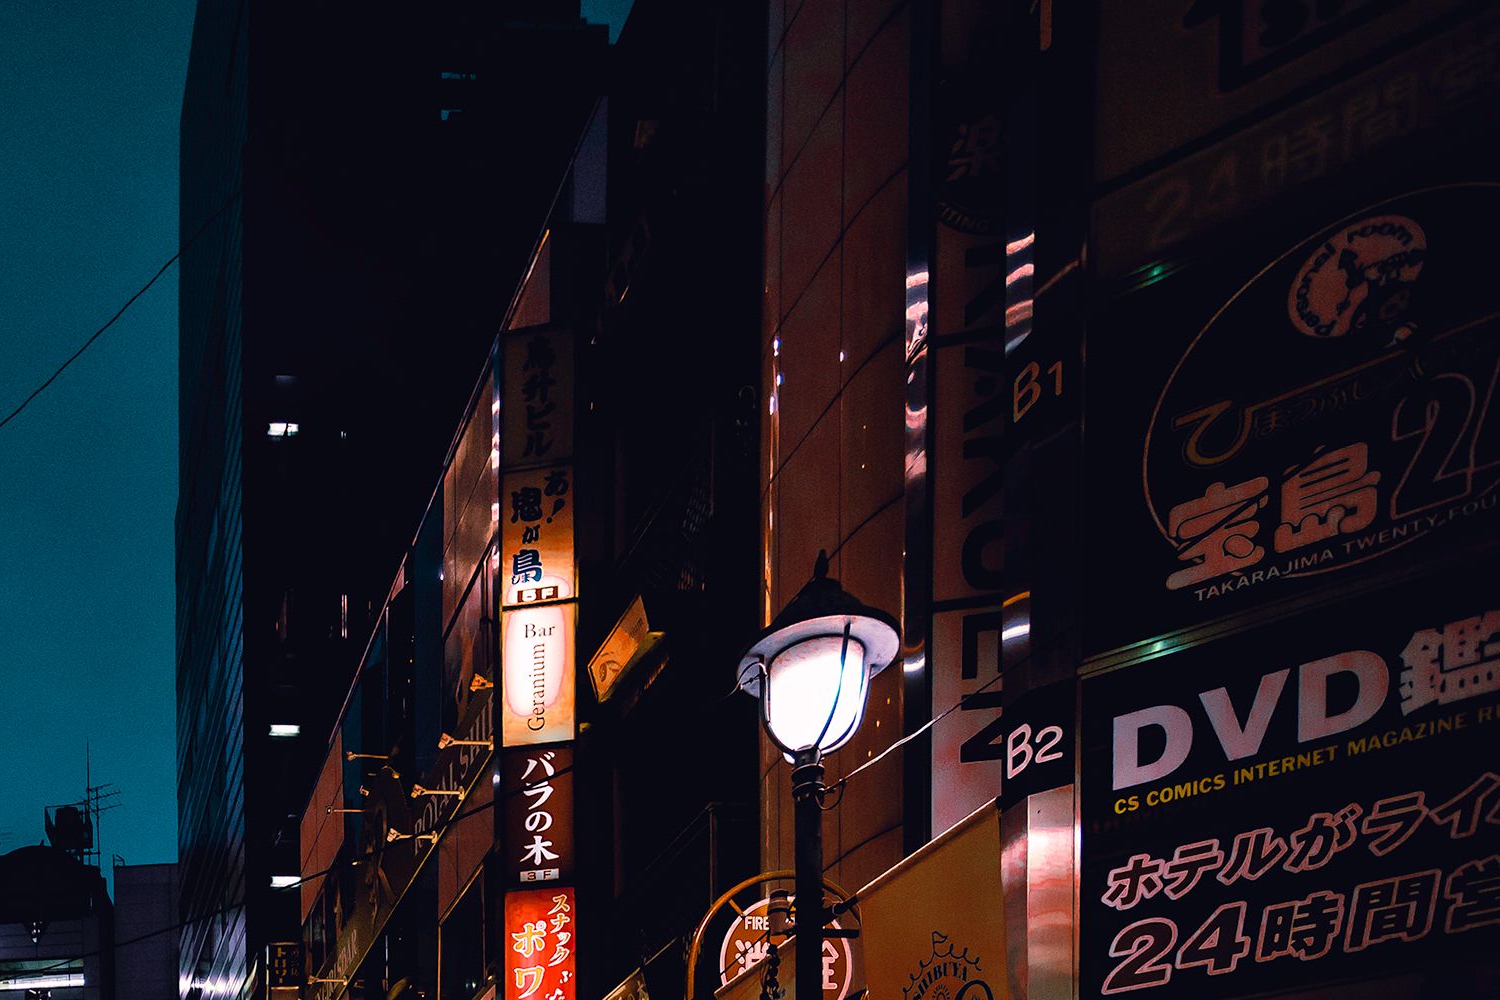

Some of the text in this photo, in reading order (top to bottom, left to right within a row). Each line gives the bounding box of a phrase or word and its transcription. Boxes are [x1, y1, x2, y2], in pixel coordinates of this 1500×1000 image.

[1194, 546, 1334, 603] TAKARAJIMA
[1344, 509, 1445, 556] TWENTY
[524, 622, 556, 639] Bar
[528, 641, 547, 733] Geranium
[1005, 722, 1065, 780] B2
[1113, 795, 1140, 815] CS
[1145, 773, 1226, 807] COMICS
[1233, 744, 1338, 788] INTERNET
[1346, 713, 1468, 757] MAGAZINE
[519, 750, 560, 865] バラの木
[527, 869, 555, 881] 3F
[512, 919, 547, 999] ポワ
[547, 893, 572, 967] スナック
